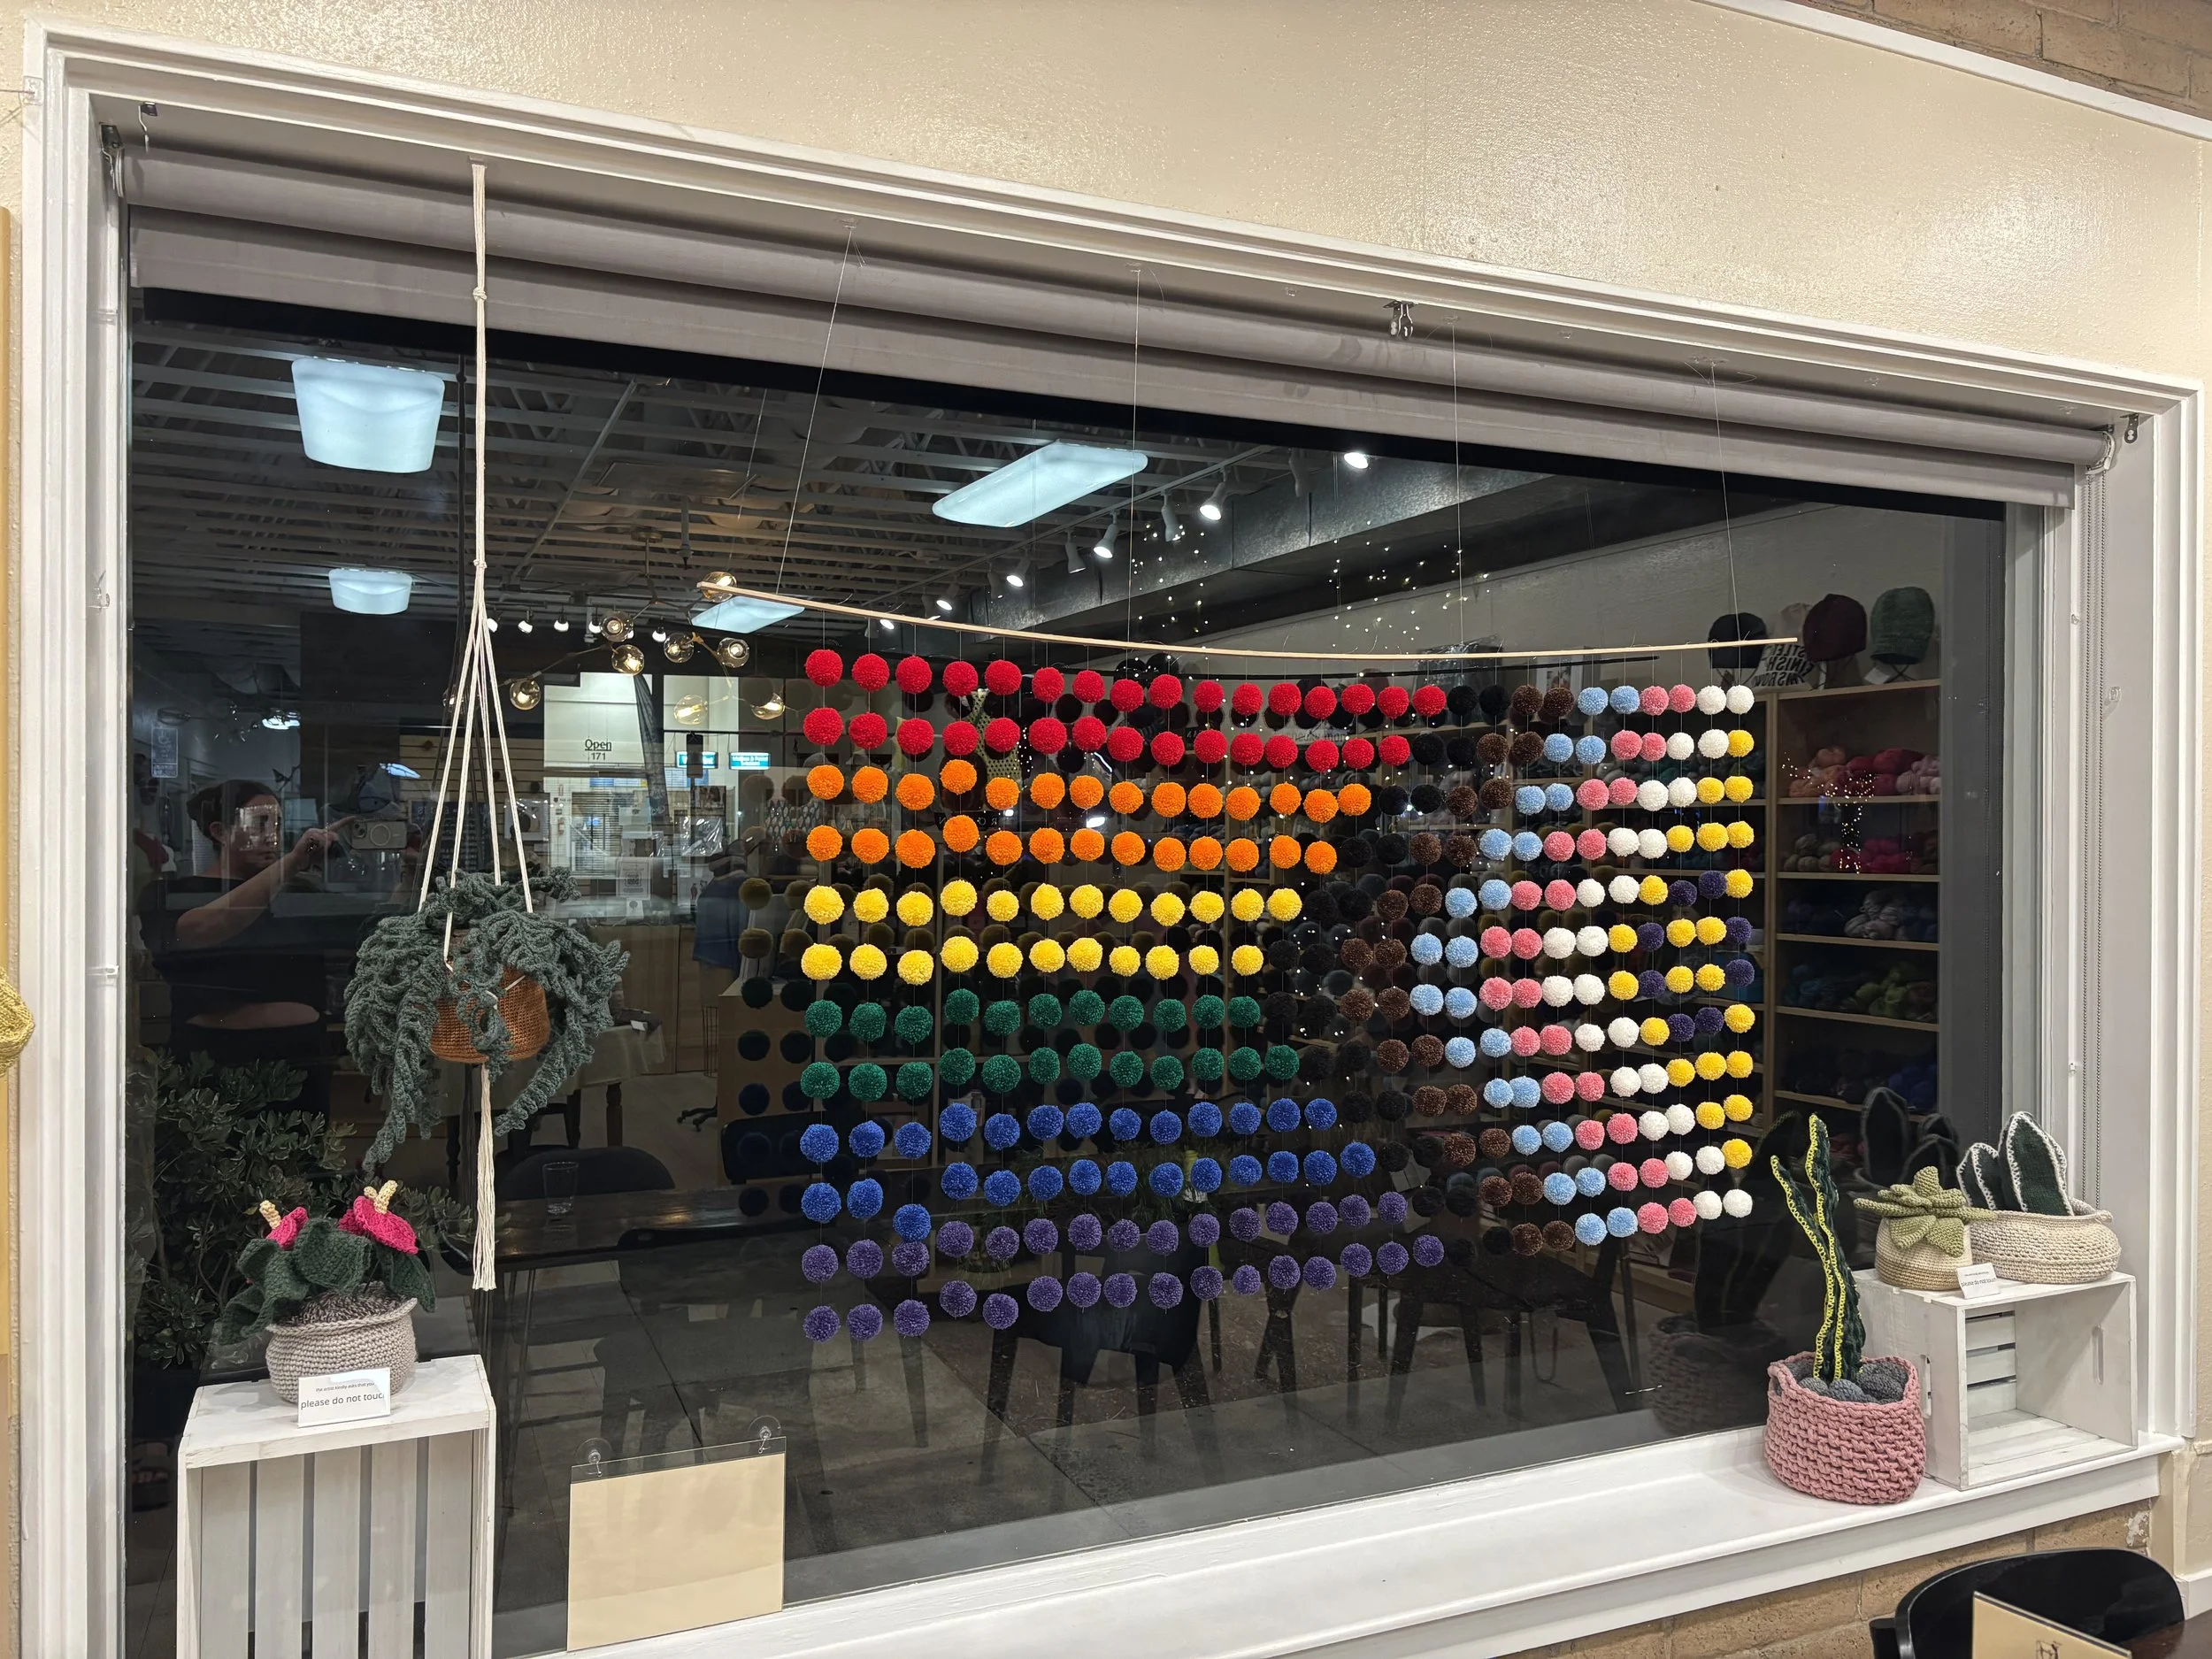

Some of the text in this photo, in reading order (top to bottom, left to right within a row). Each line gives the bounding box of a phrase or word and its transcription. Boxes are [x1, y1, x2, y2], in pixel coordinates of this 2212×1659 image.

[585, 738, 612, 752] Open
[591, 752, 606, 761] 171
[301, 1398, 330, 1410] please
[332, 1396, 343, 1405] do
[346, 1394, 361, 1403] not
